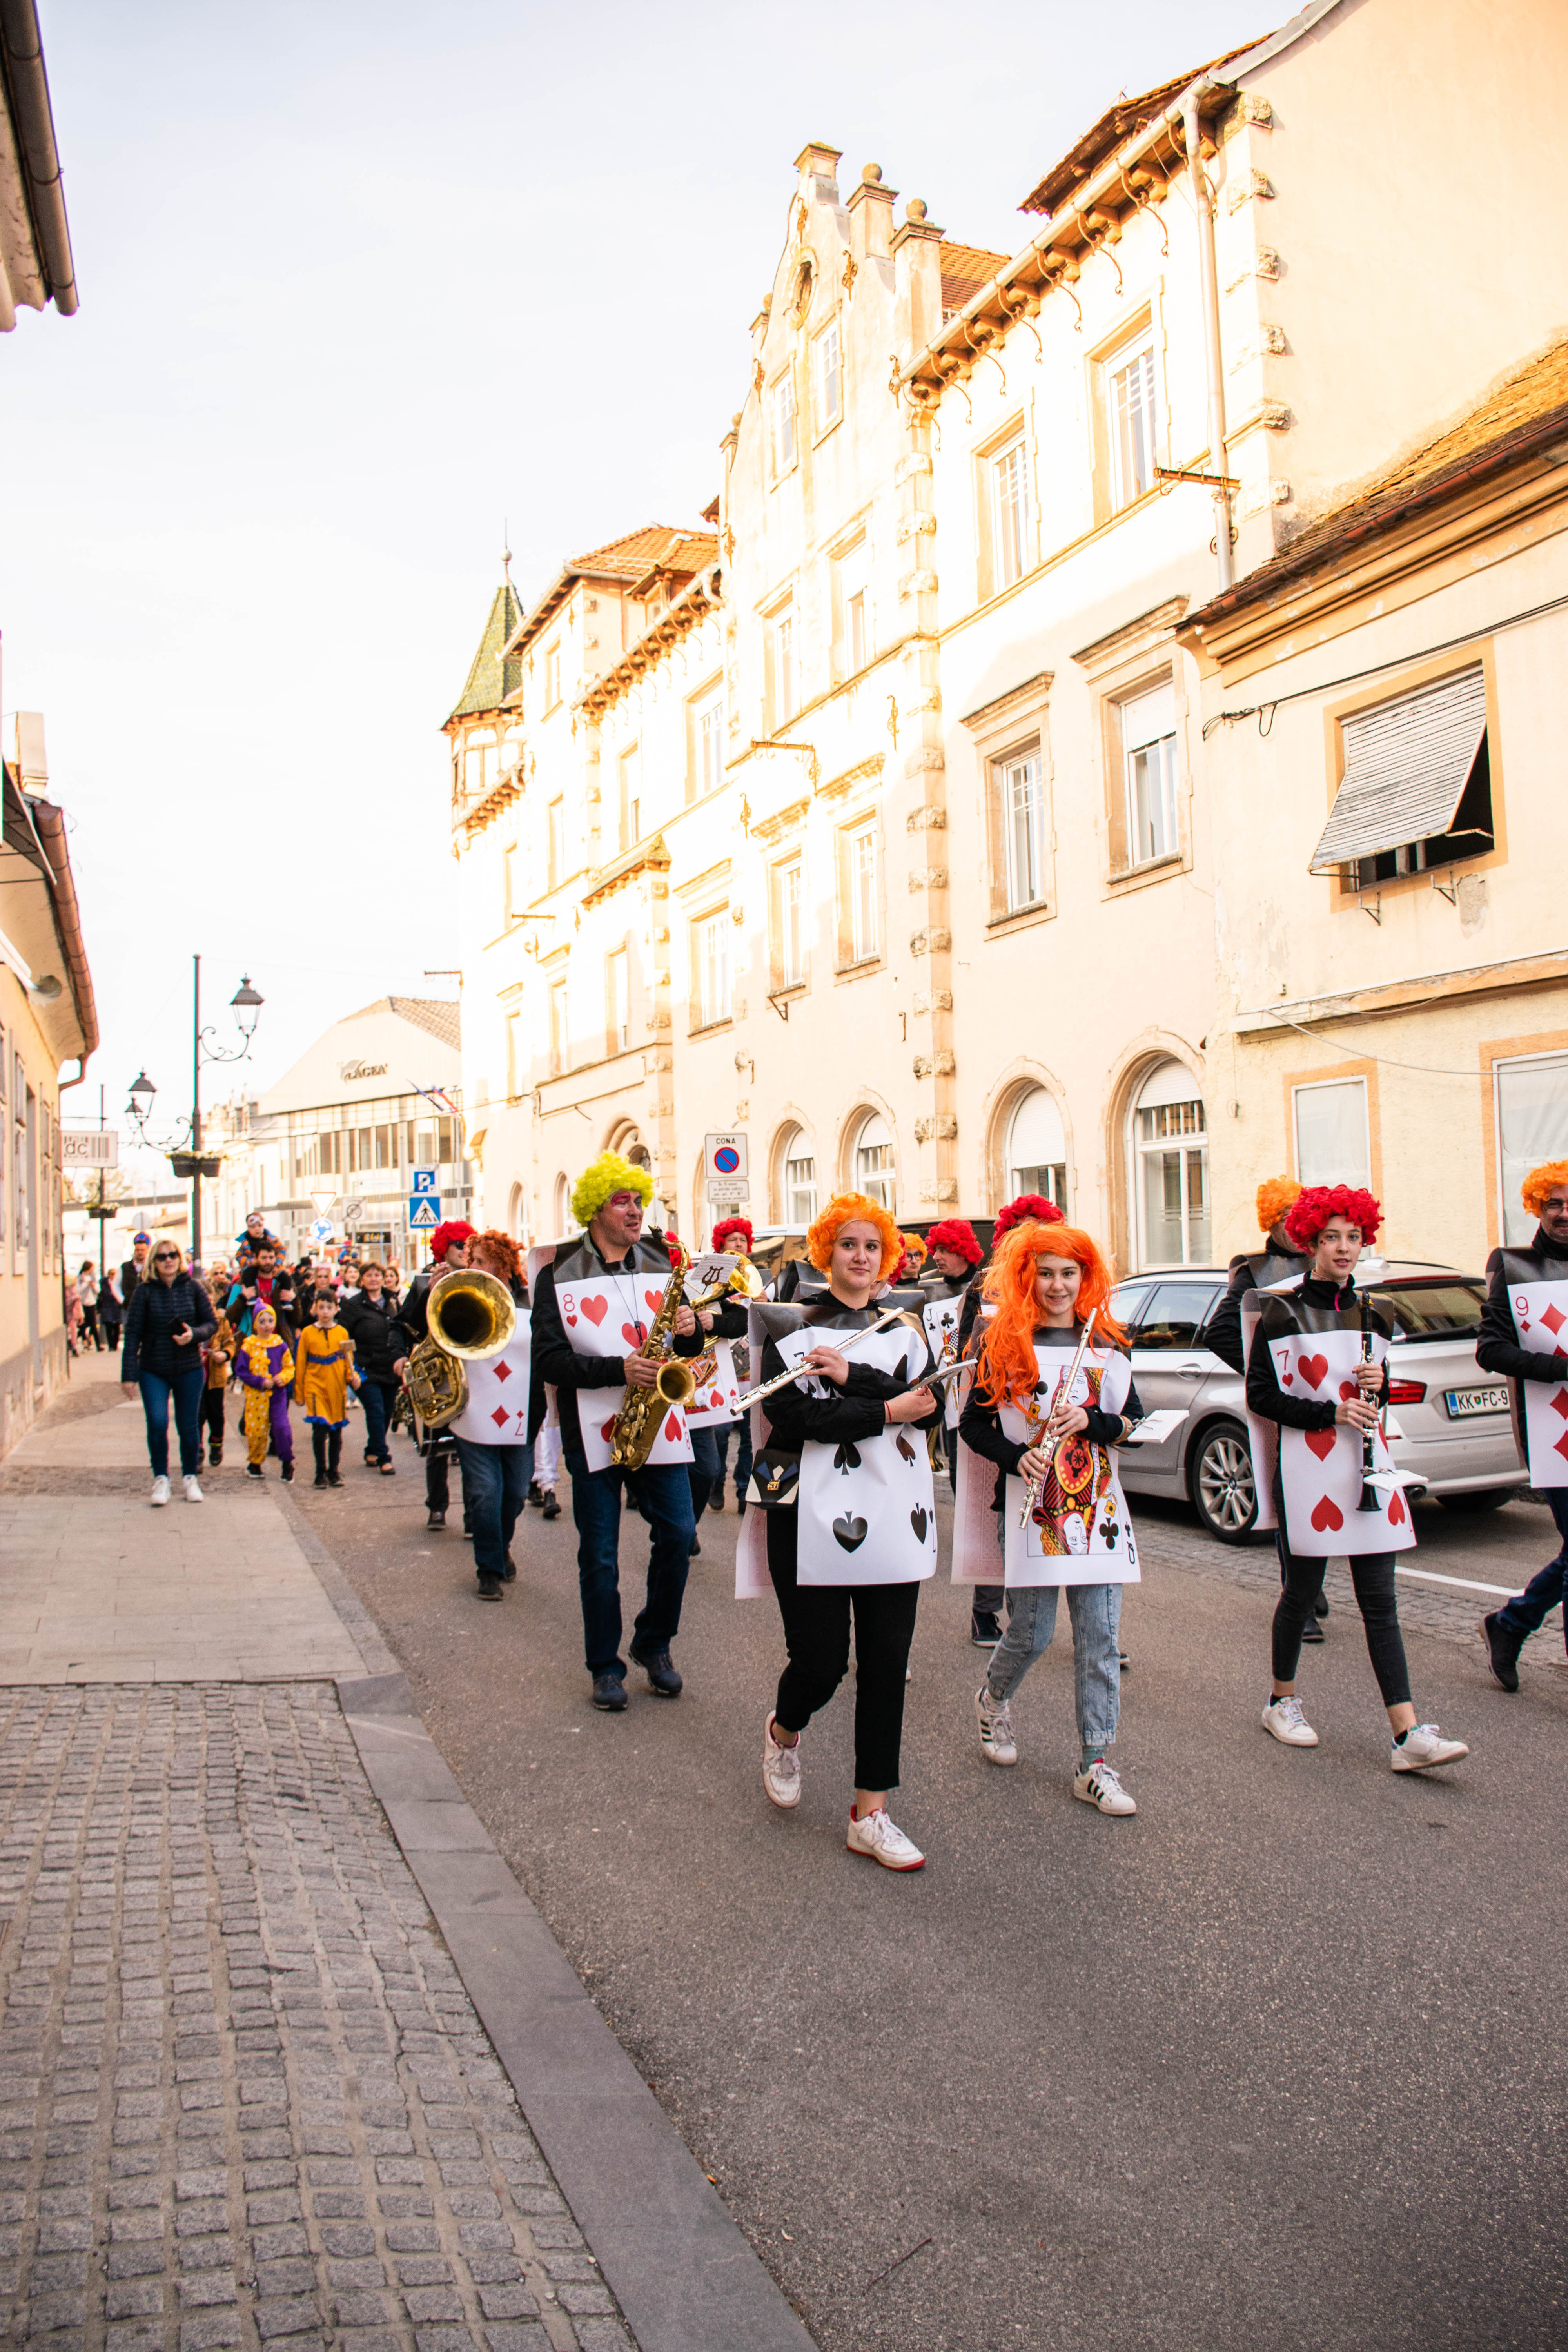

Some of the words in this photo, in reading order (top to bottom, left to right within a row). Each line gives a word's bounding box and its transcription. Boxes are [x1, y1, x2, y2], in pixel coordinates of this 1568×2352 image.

[563, 1294, 575, 1312] 8
[1515, 1296, 1529, 1316] 9
[926, 1308, 932, 1321] J
[1276, 1349, 1289, 1371] 7
[1457, 1394, 1475, 1410] KK
[514, 1421, 524, 1437] 7
[684, 1431, 691, 1450] 8
[1127, 1541, 1135, 1564] Q
